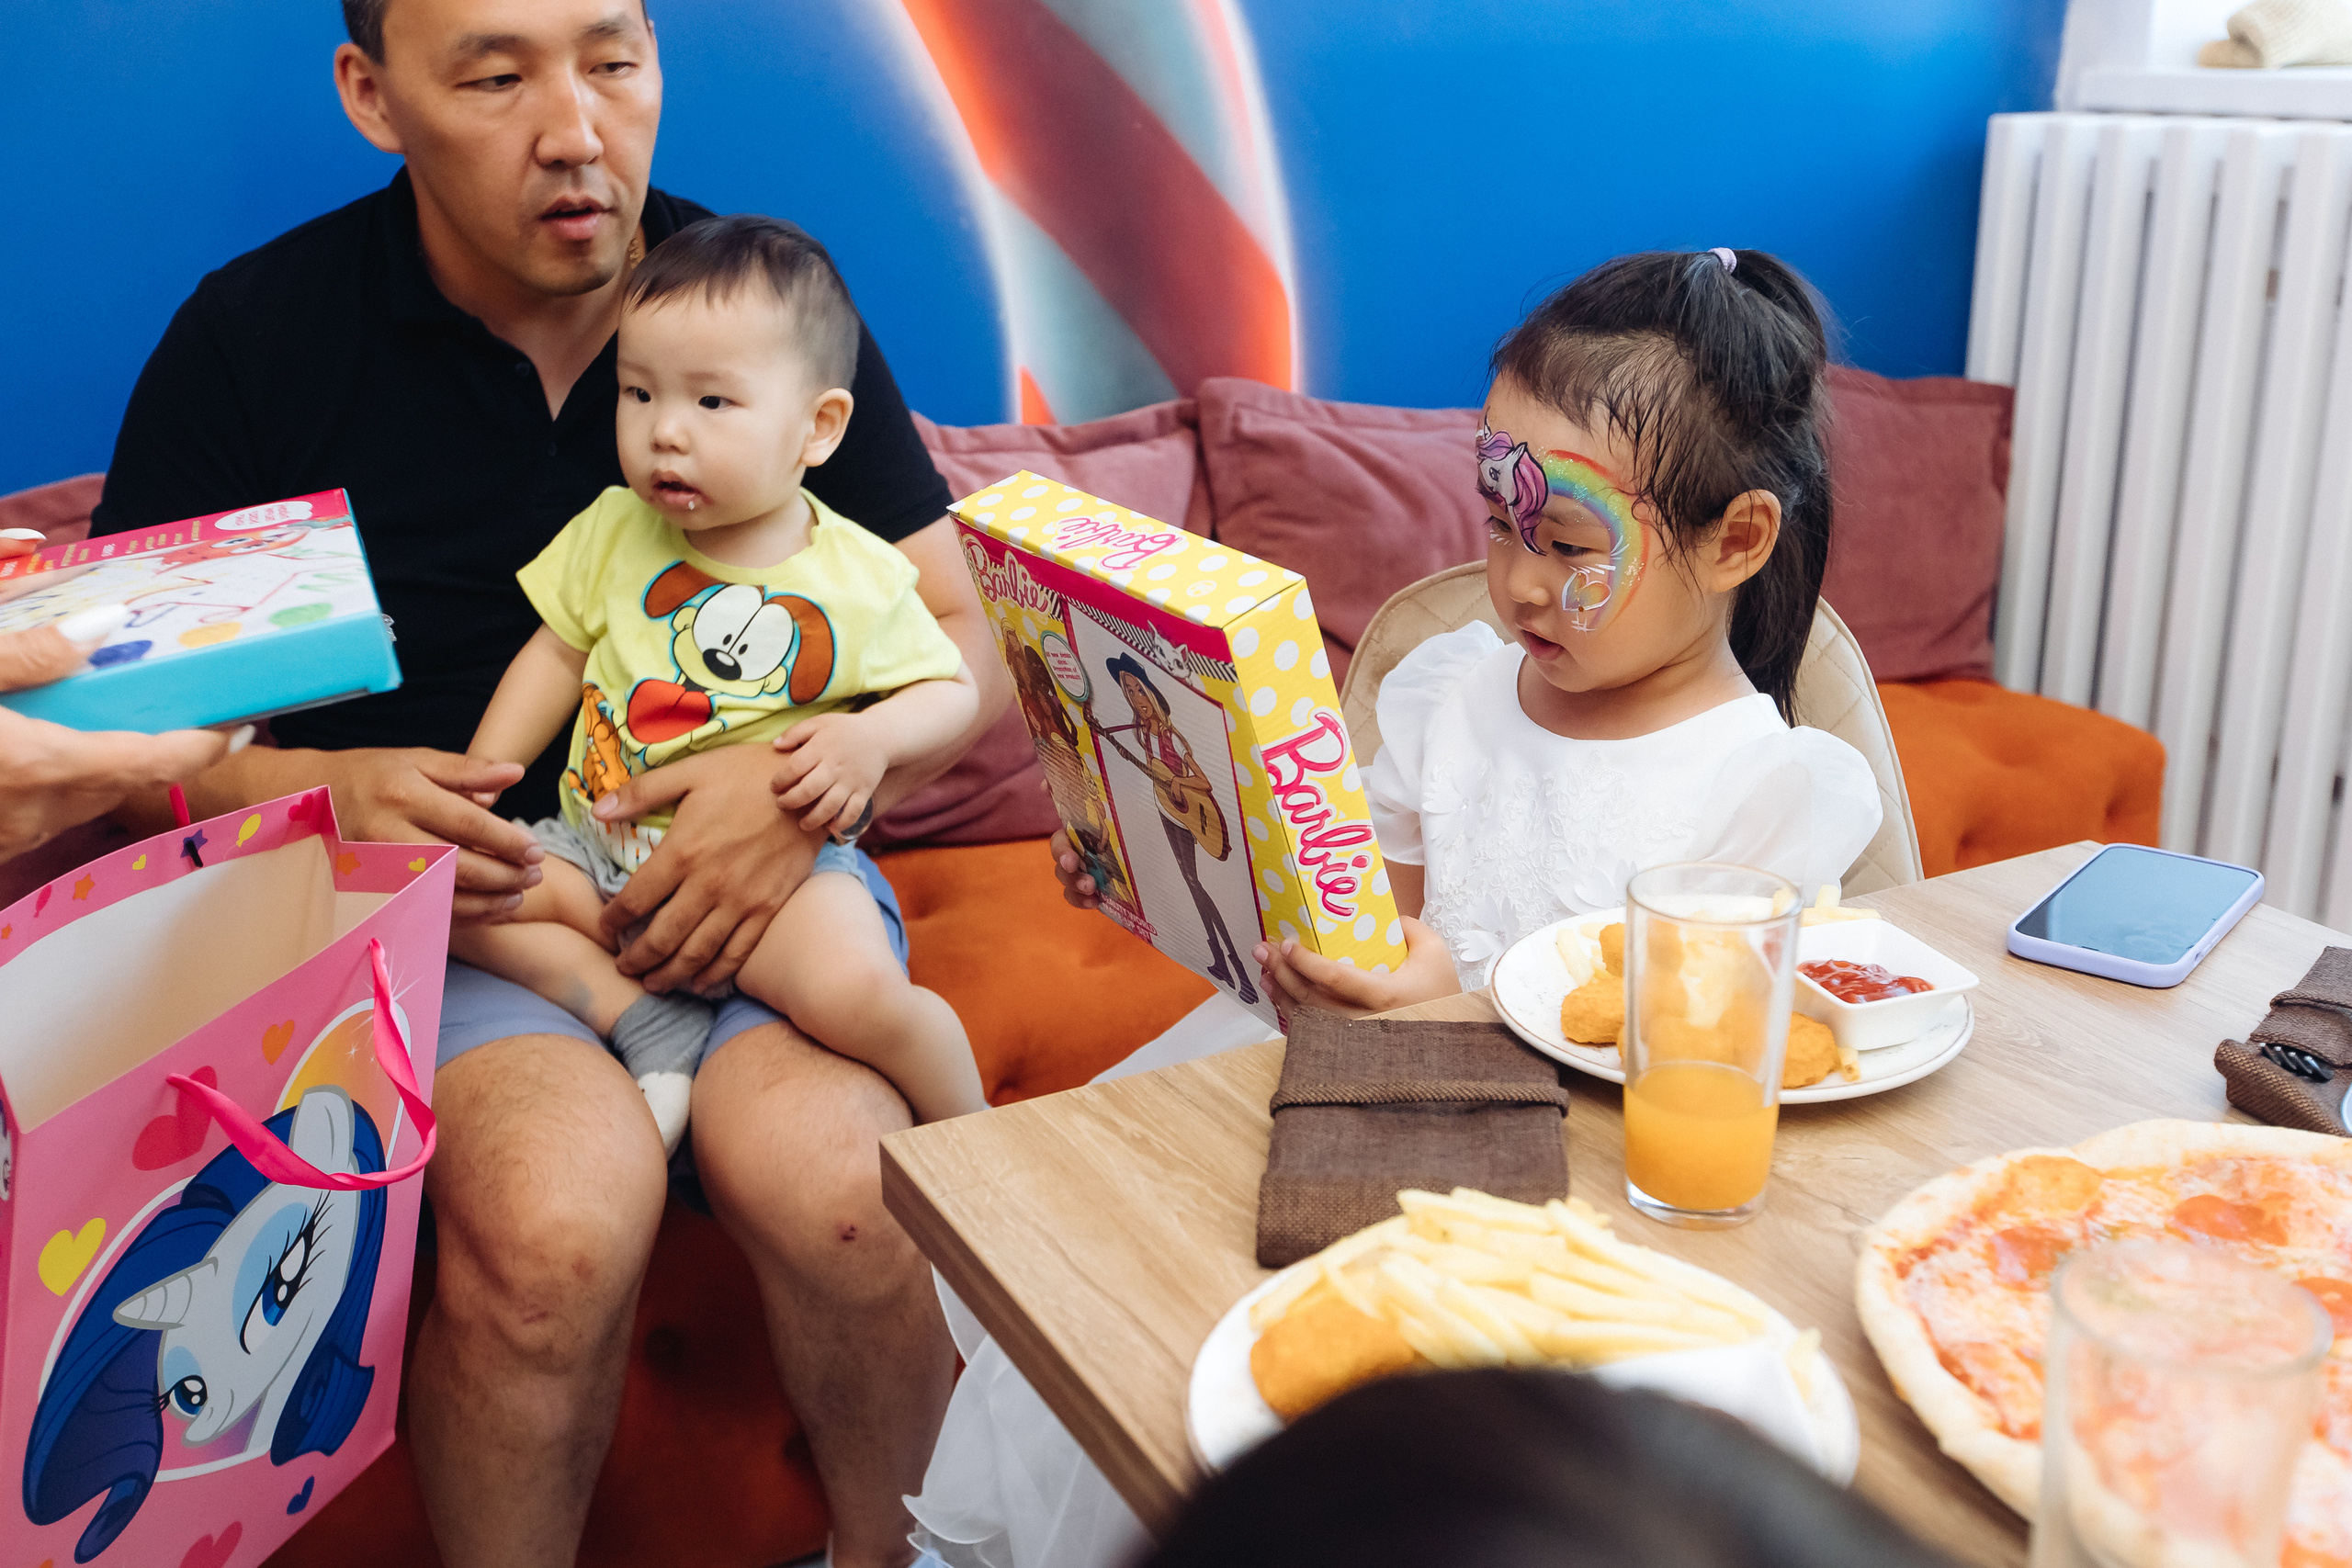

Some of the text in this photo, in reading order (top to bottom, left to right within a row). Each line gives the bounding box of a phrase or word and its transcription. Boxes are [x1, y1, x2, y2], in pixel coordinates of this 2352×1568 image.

[964, 536, 1049, 614] Barbie
[1057, 516, 1183, 571] Barbie
[1261, 711, 1375, 917] Barbie
